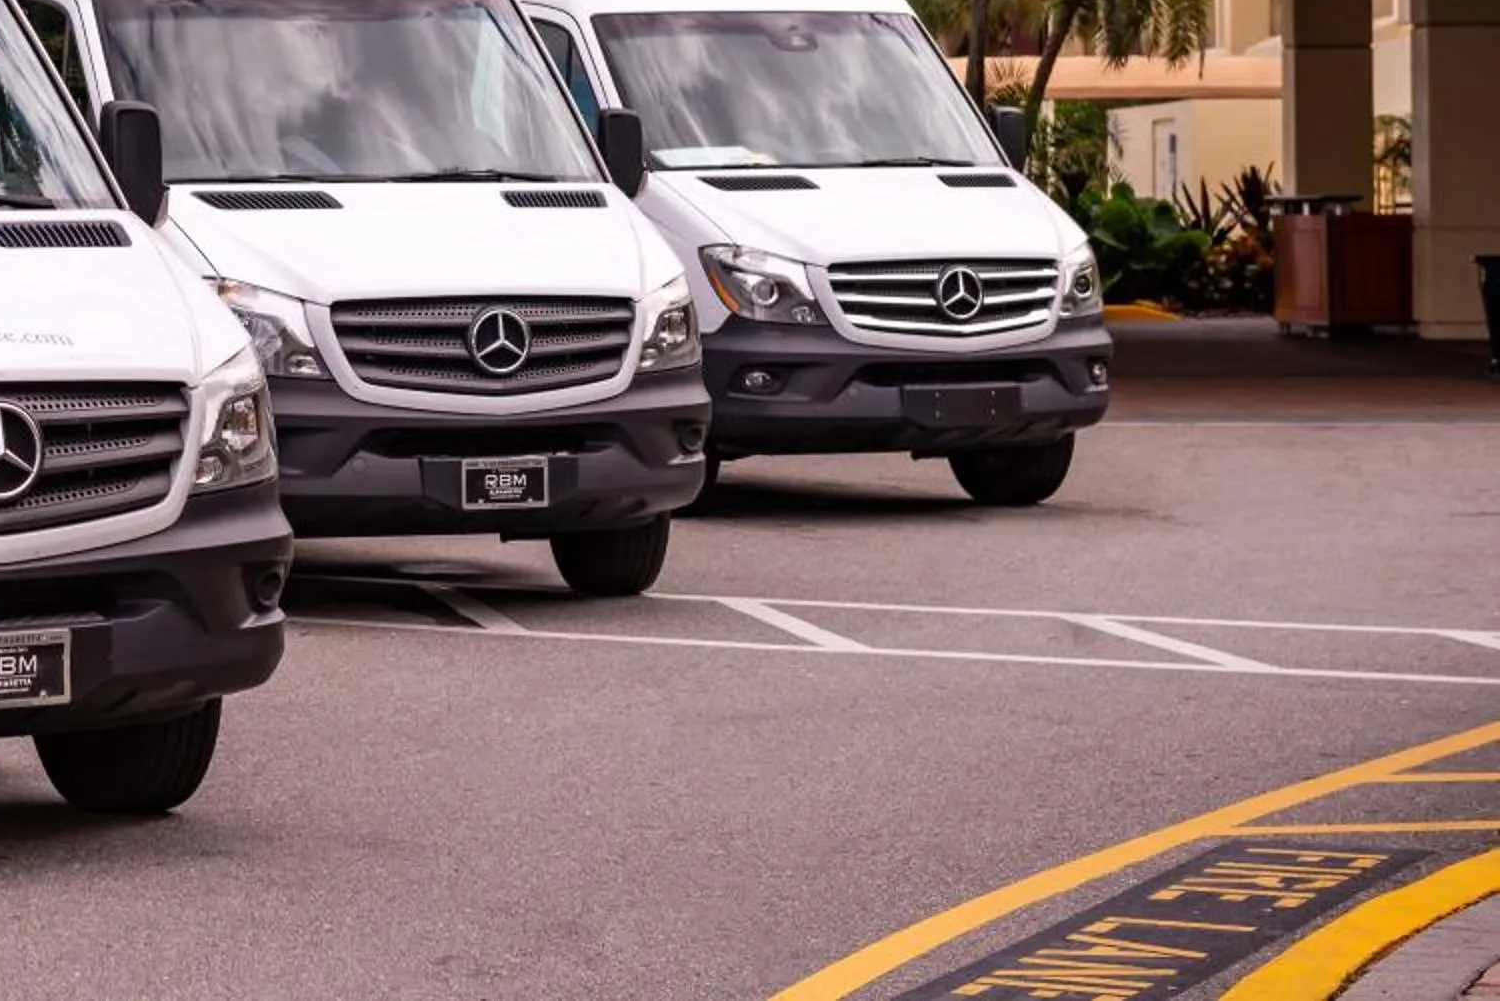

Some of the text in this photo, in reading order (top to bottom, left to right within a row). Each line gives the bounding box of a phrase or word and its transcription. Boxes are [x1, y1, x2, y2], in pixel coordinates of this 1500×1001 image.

[485, 473, 527, 489] RBM
[951, 847, 1390, 1001] FIRE LANE
